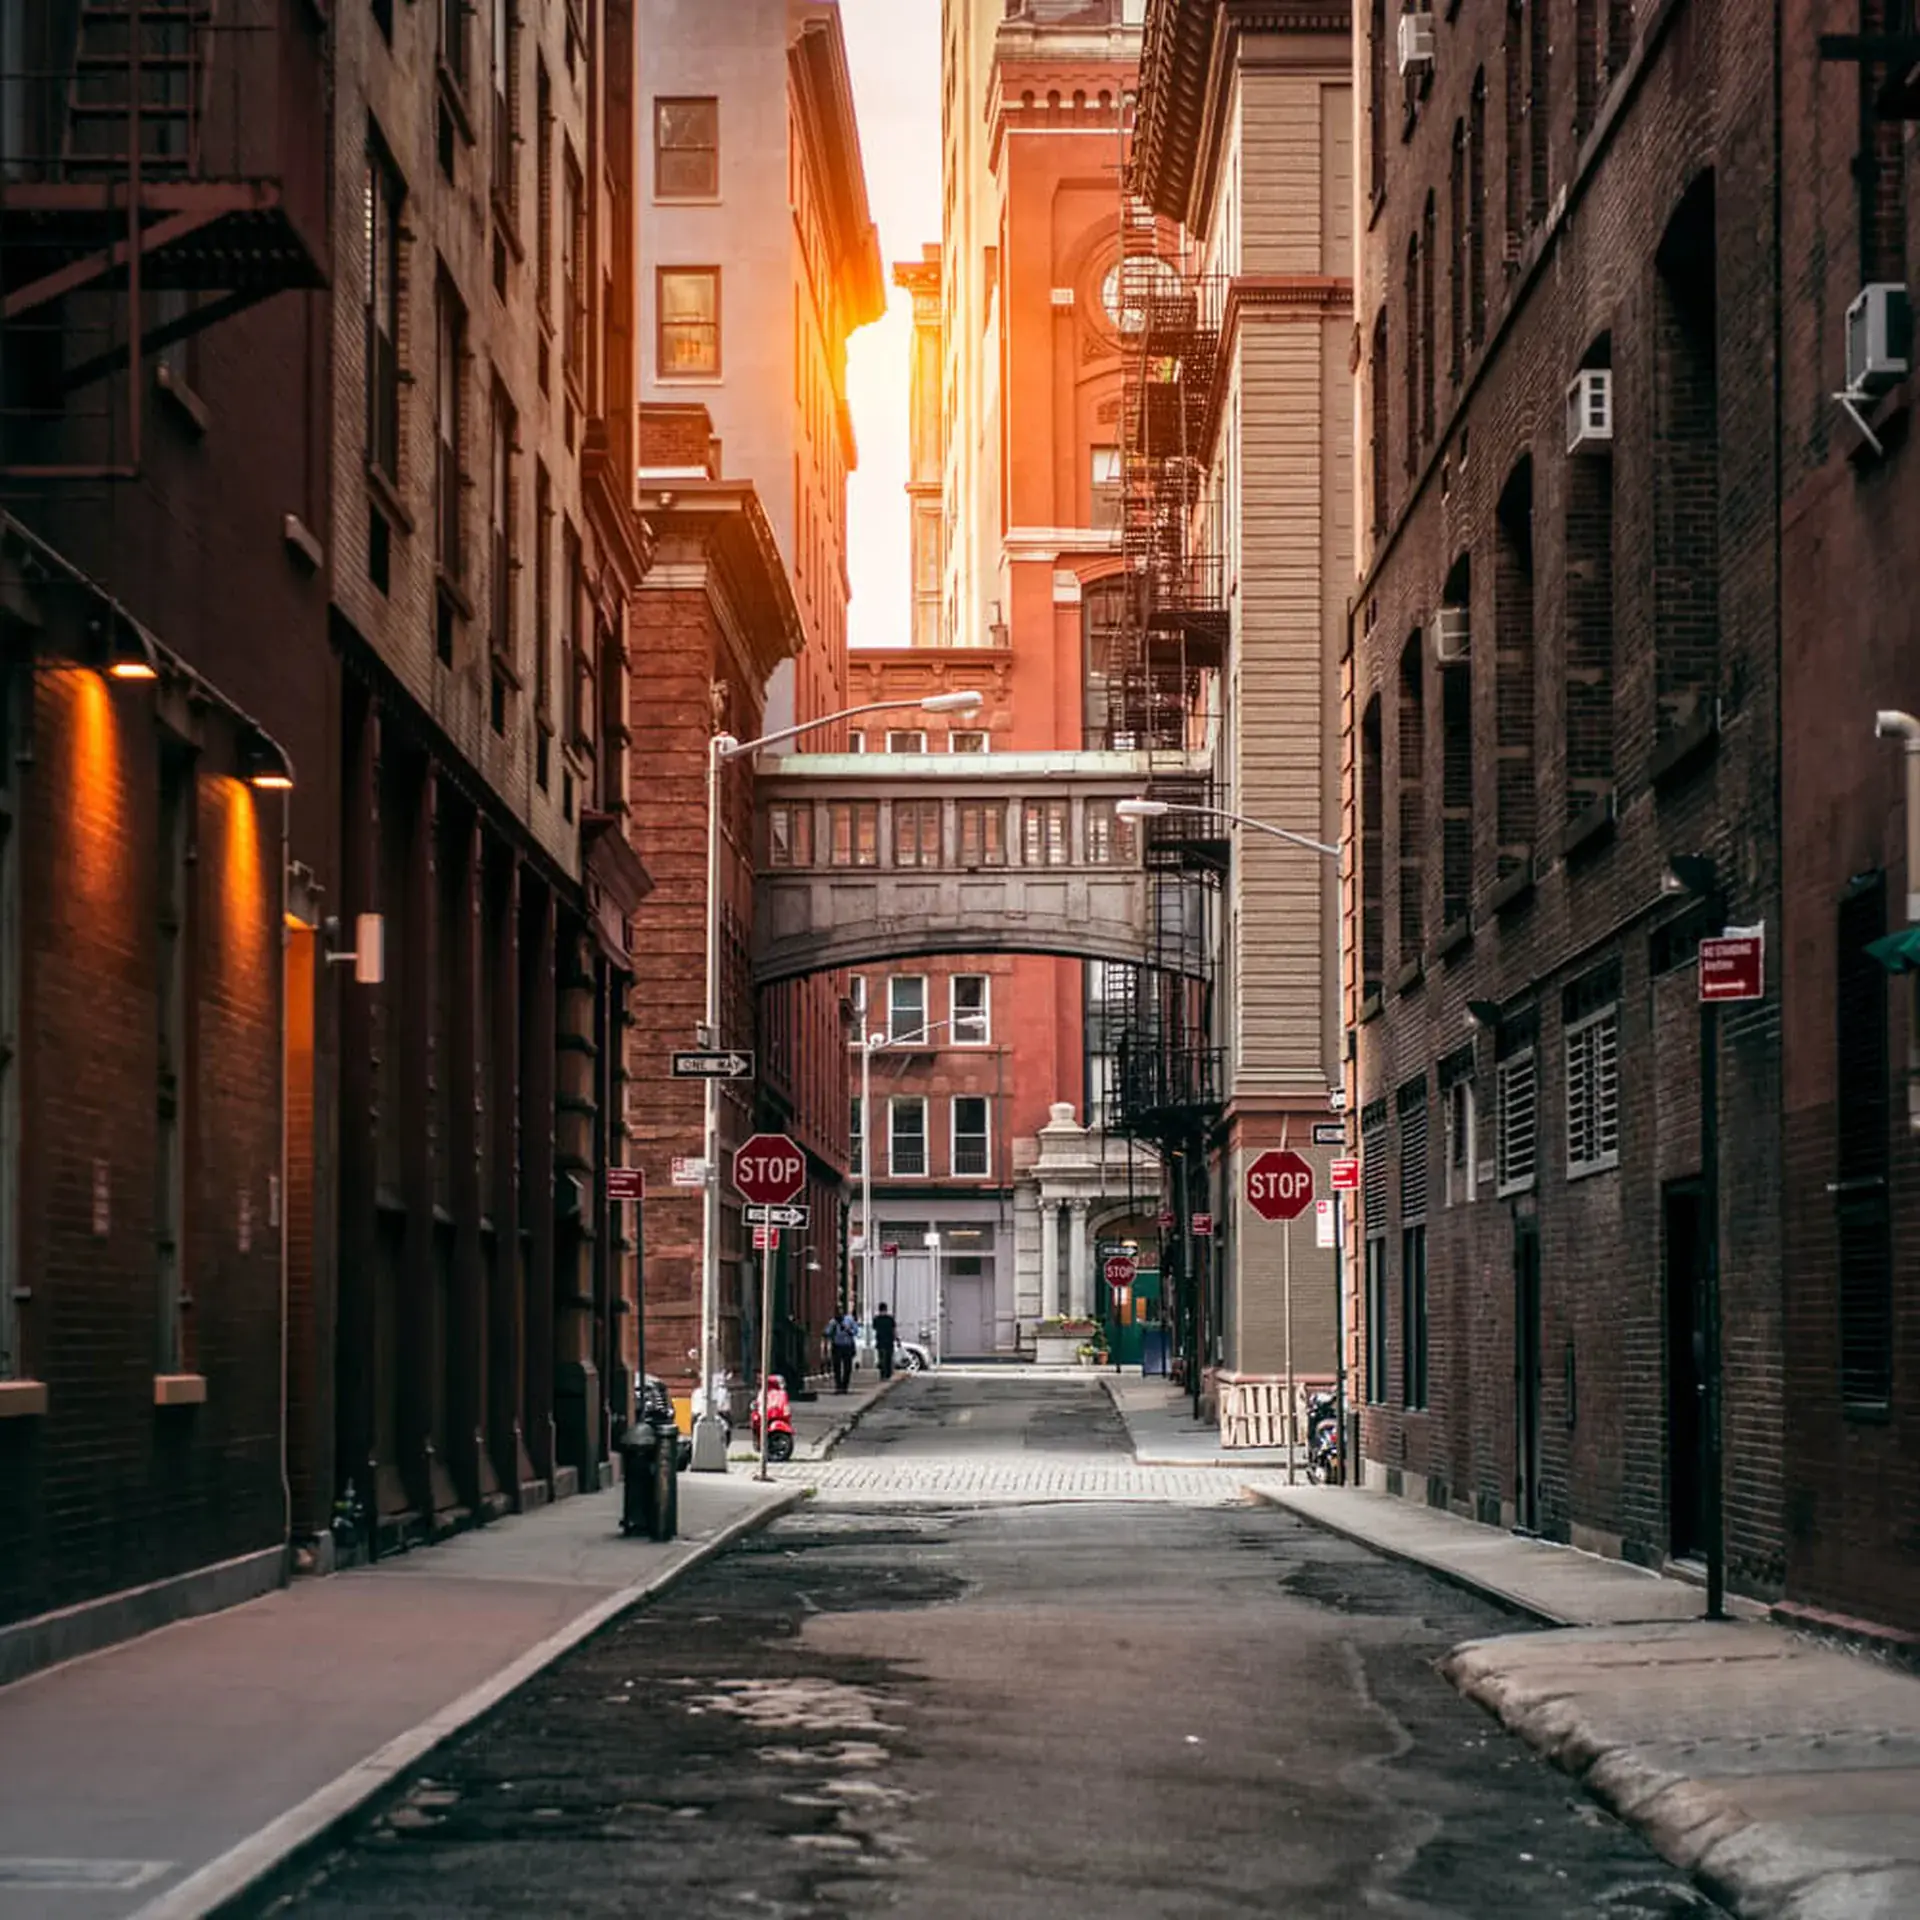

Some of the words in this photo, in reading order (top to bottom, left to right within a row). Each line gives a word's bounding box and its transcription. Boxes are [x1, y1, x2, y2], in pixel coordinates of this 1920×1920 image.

[682, 1059, 707, 1071] ONE
[717, 1059, 741, 1071] WAY
[739, 1156, 801, 1184] STOP
[1250, 1172, 1310, 1199] STOP
[1107, 1265, 1134, 1279] STOP
